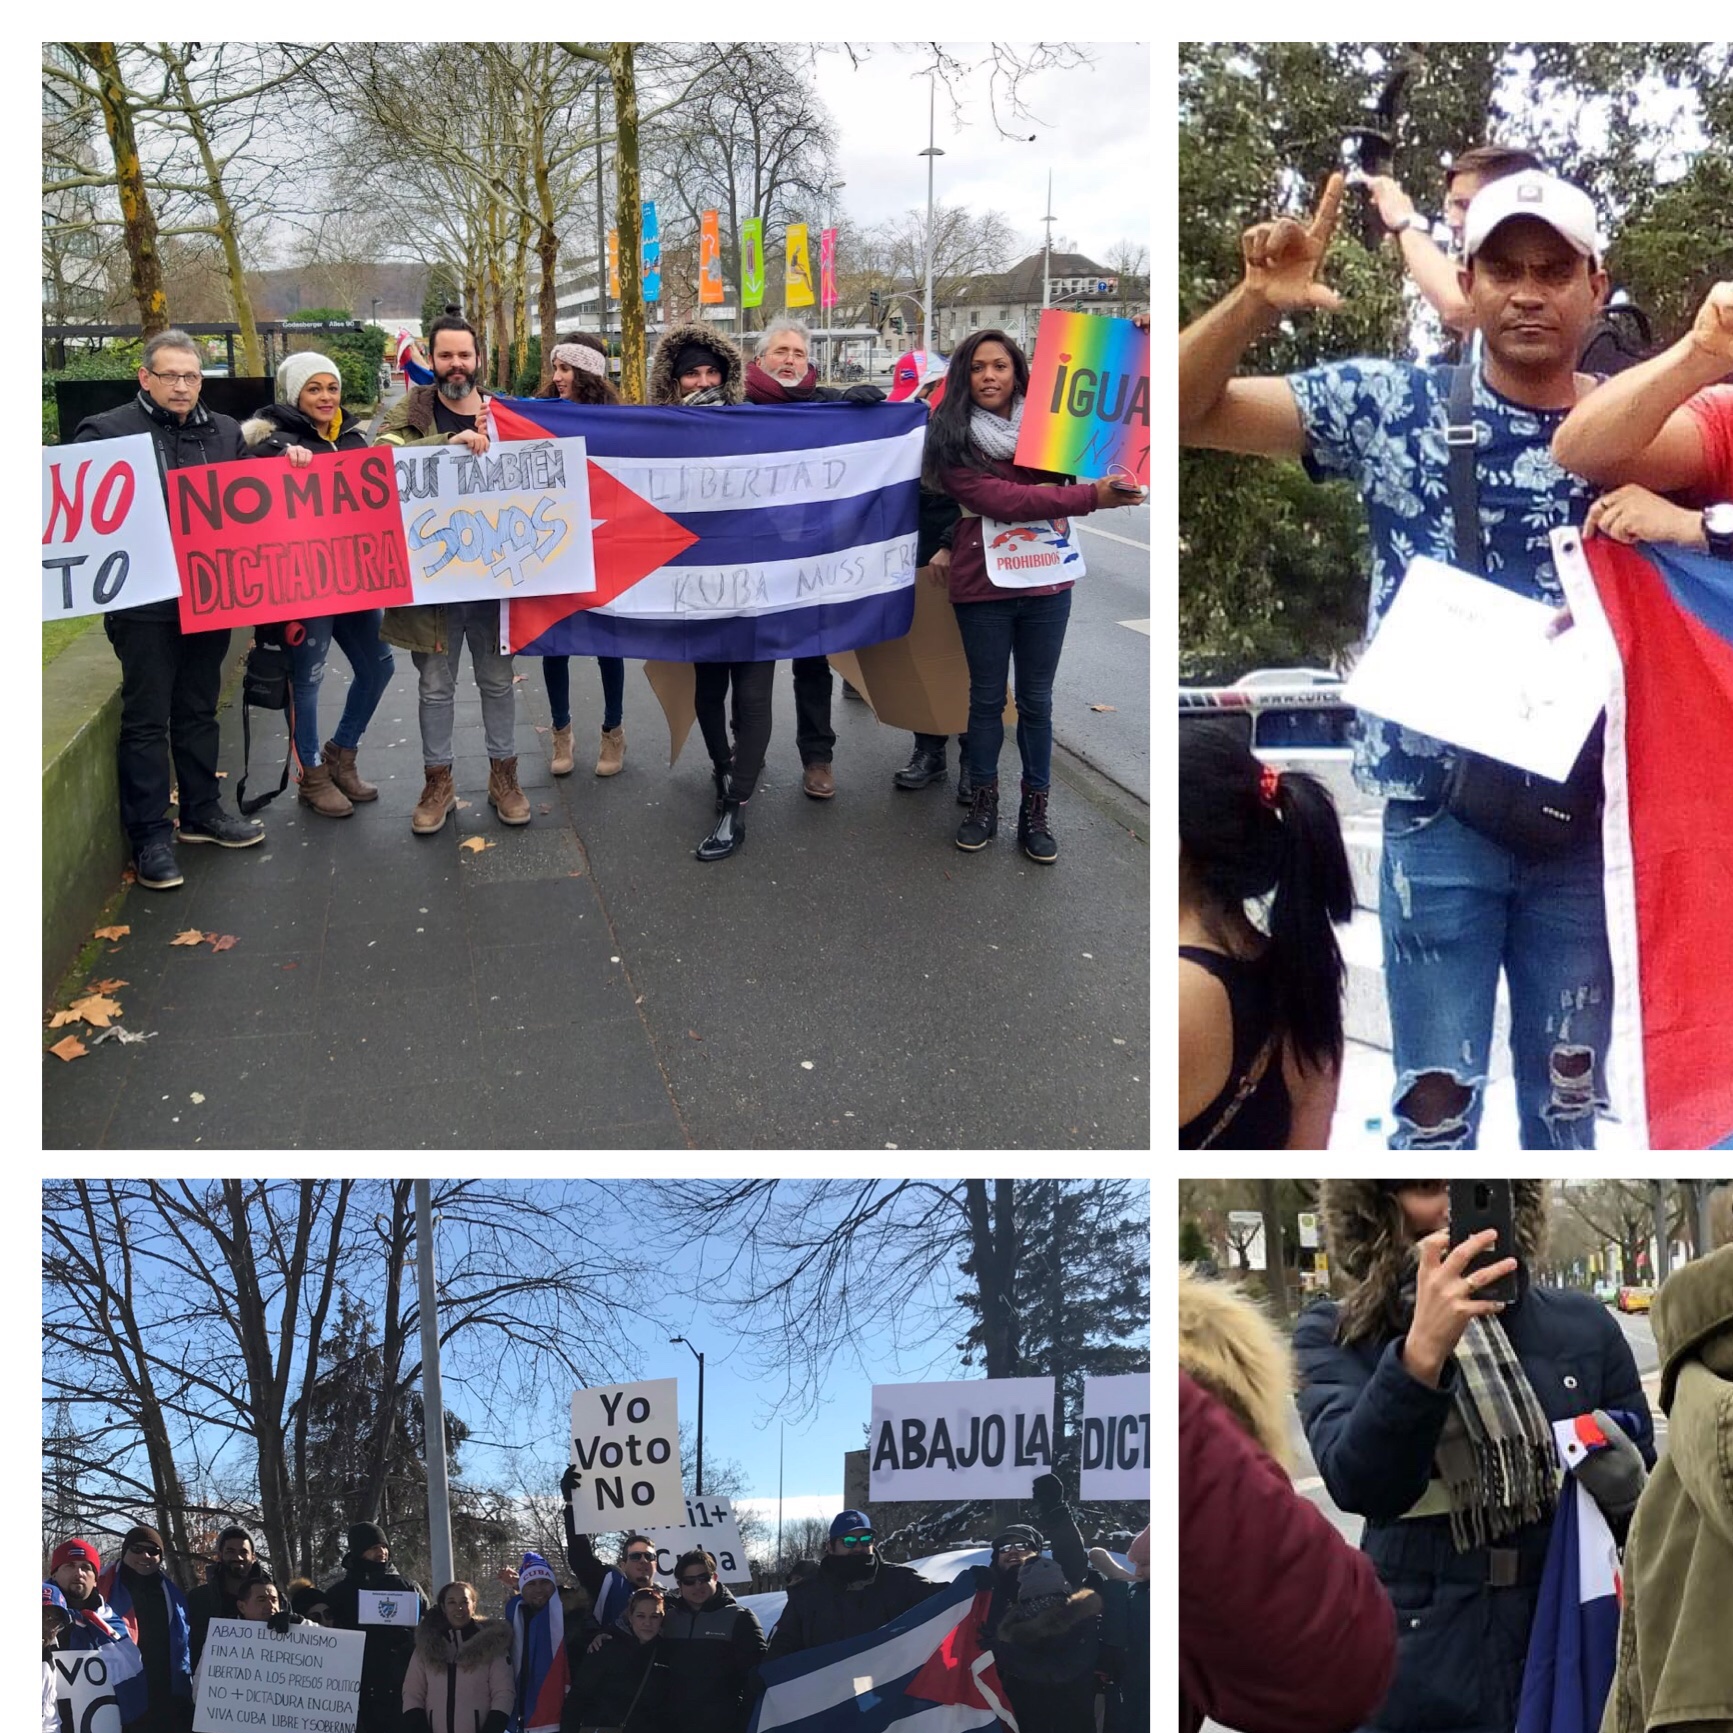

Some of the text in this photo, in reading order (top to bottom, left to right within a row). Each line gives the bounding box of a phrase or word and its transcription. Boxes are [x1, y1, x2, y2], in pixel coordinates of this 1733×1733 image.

[177, 457, 391, 535] NO MÁS
[649, 459, 847, 501] LIBERTAD
[42, 459, 135, 543] NO
[408, 496, 567, 577] SOMOS
[187, 530, 406, 615] DICTADURA
[997, 552, 1060, 571] PROHIBIDOS
[42, 550, 130, 609] TO
[674, 568, 769, 613] KUBA
[796, 556, 865, 599] MUSS
[600, 1392, 650, 1426] Yo
[574, 1434, 671, 1470] Voto
[872, 1413, 1052, 1472] ABAJO LA
[595, 1476, 655, 1511] No
[523, 1569, 551, 1581] CUBA
[212, 1626, 253, 1639] ABAJO
[269, 1630, 338, 1649] COMUNISMO
[210, 1645, 228, 1657] FIN
[241, 1647, 255, 1660] LA
[261, 1649, 323, 1668] REPRESION
[208, 1665, 361, 1693] LIBERTAD A LOS PRESOS POLITICO
[208, 1686, 227, 1699] NO
[246, 1689, 304, 1709] DICTADURA
[321, 1700, 354, 1714] CUBA
[207, 1707, 234, 1721] VIVA
[237, 1710, 266, 1725] CUBA
[272, 1713, 299, 1729] LIBRE
[310, 1719, 357, 1733] SOBERANA
